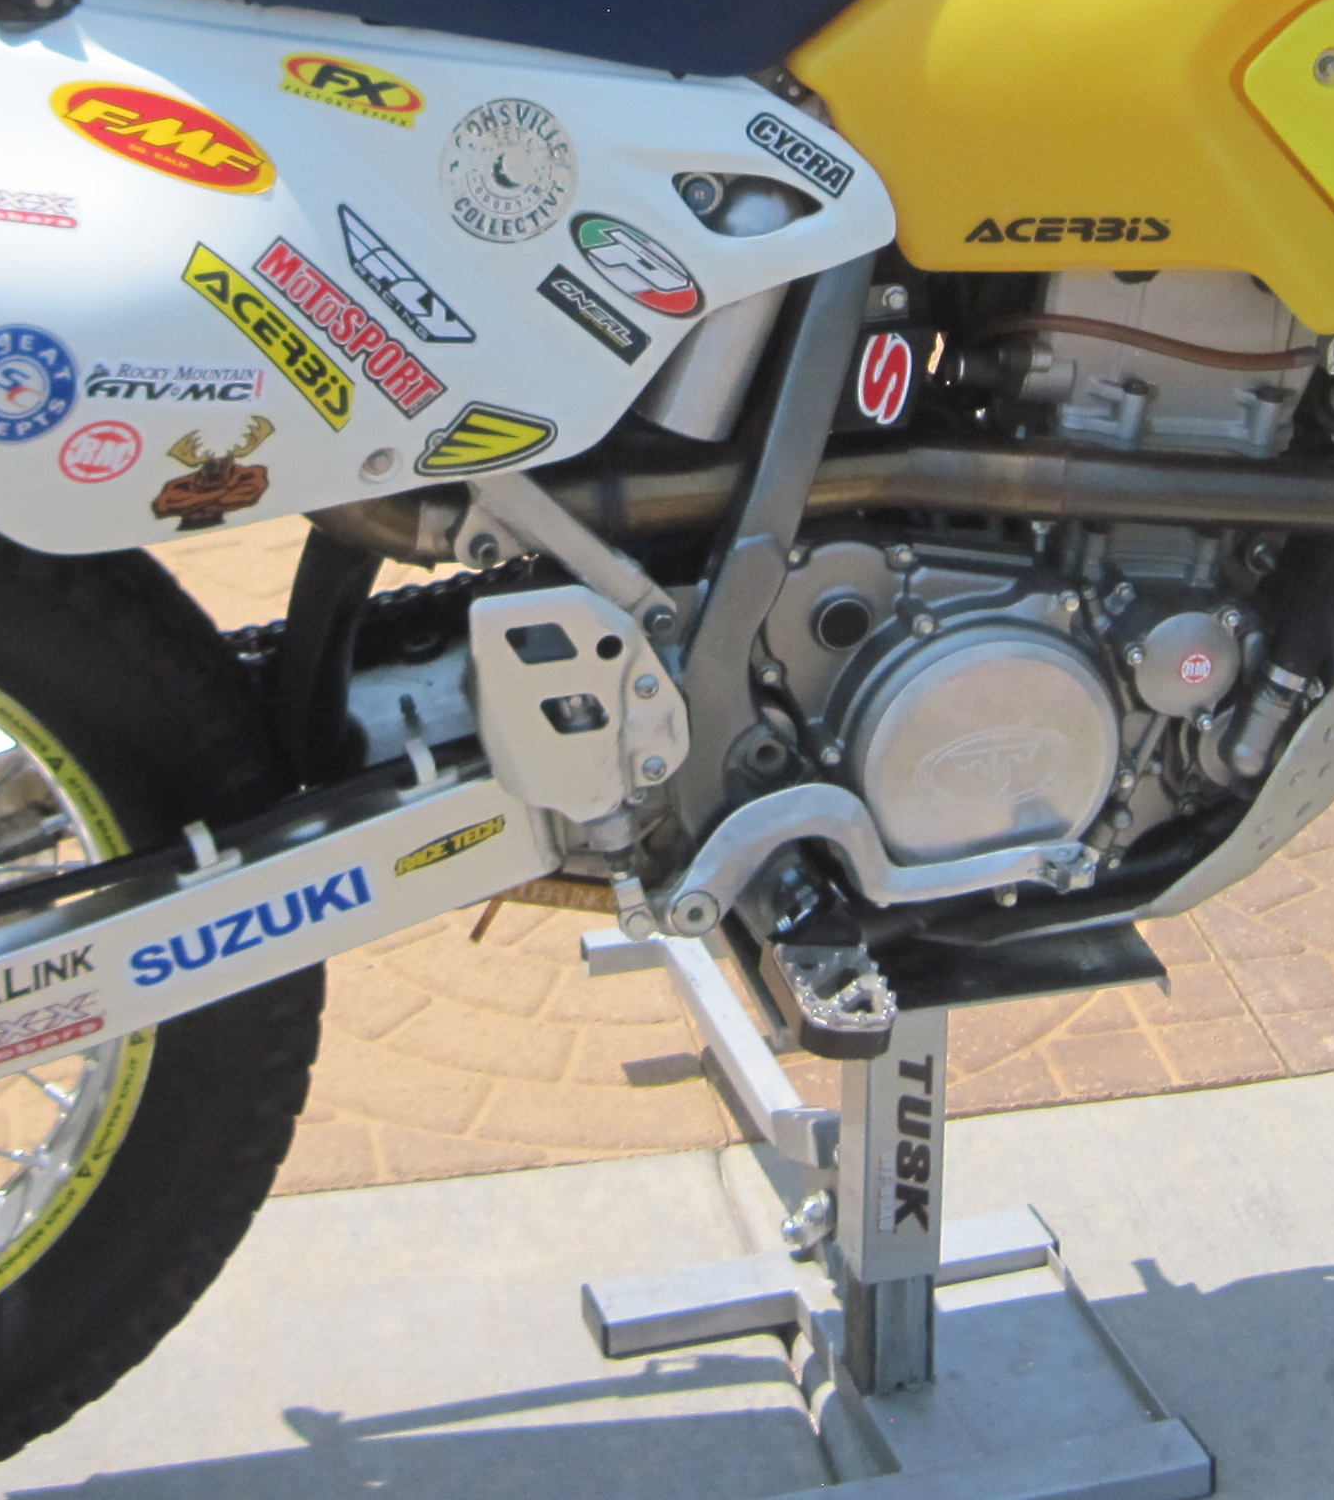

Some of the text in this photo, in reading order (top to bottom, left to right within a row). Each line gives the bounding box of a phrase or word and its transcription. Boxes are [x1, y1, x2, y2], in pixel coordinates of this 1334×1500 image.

[310, 63, 402, 108] FX
[63, 98, 266, 173] FMF
[752, 117, 848, 192] CYCRA
[964, 216, 1171, 244] ACERBIS
[116, 363, 256, 381] ROCKY MOUNTAIN
[193, 269, 351, 418] ACERBIS
[129, 865, 373, 987] SUZUKI
[894, 1053, 934, 1235] TUSK
